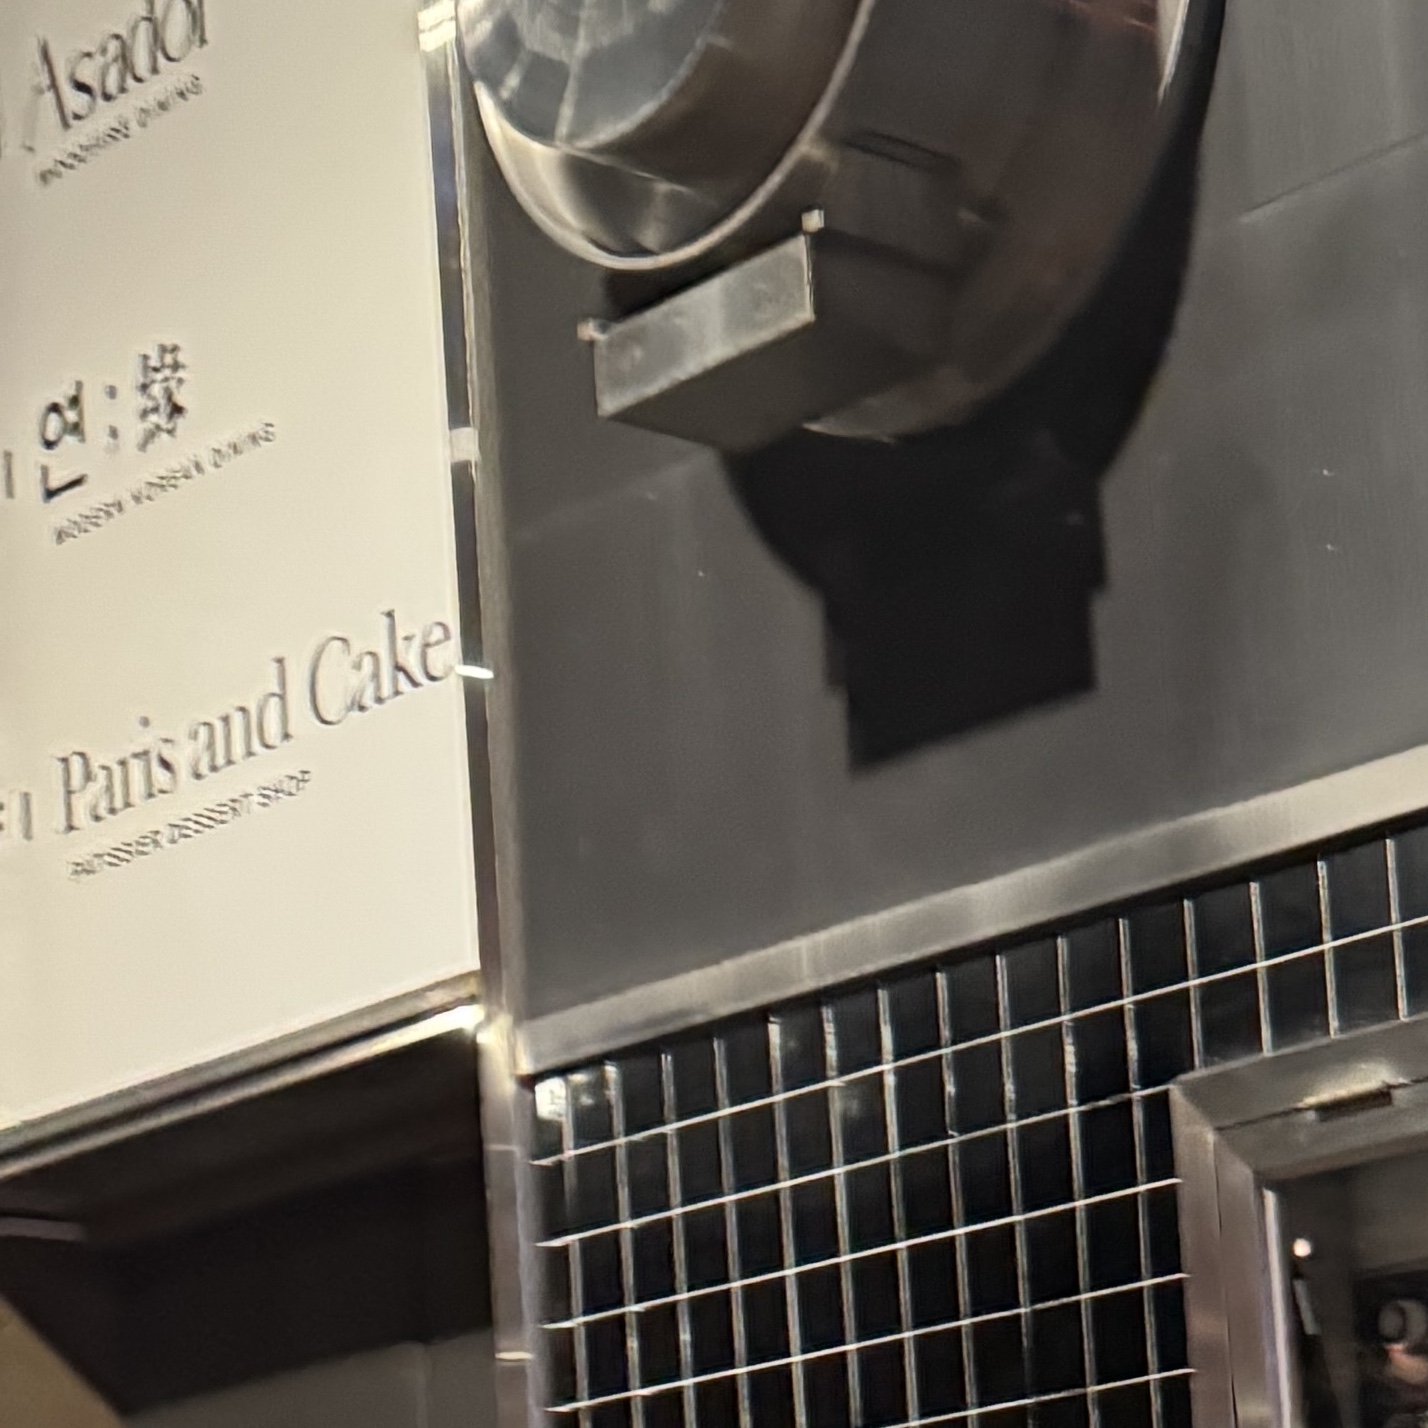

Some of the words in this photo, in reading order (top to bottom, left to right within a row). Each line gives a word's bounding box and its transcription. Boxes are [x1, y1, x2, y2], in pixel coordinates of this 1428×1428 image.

[53, 716, 180, 835] Paris
[188, 655, 294, 782] and
[308, 607, 454, 728] Cake
